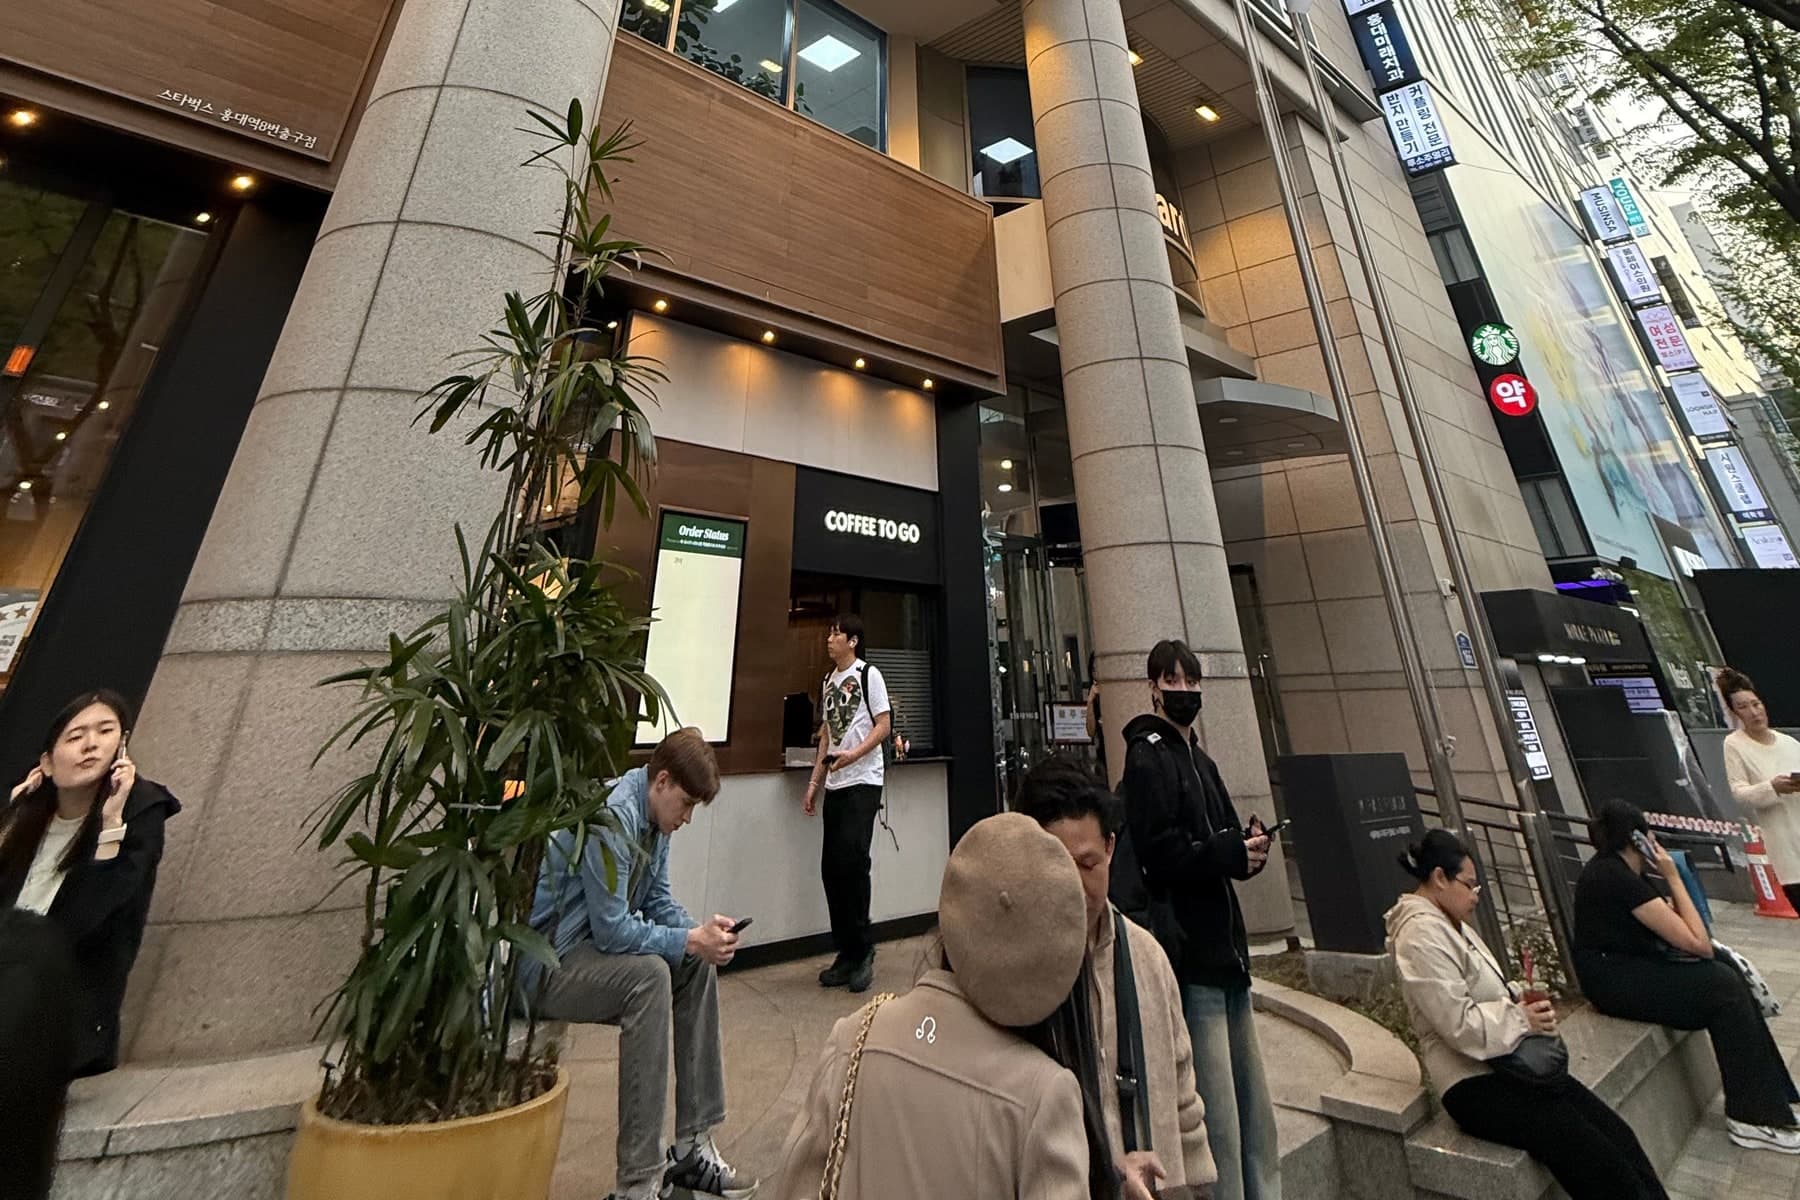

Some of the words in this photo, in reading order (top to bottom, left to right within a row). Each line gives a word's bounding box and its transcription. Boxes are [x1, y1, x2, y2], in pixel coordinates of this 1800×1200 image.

[1367, 12, 1406, 82] 홍대미래치과
[156, 89, 214, 114] 스타벅스
[219, 108, 318, 149] 홍대역8번출구점
[1386, 92, 1405, 117] 반지
[1396, 118, 1419, 154] 만들기
[1408, 84, 1432, 120] 커플링
[1422, 121, 1443, 147] 전문
[1591, 192, 1617, 233] MUSINSA
[1496, 379, 1527, 408] 약
[678, 525, 704, 538] Order
[703, 528, 730, 541] Status
[824, 510, 877, 536] COFFEE
[878, 518, 898, 540] TO
[898, 522, 920, 543] GO
